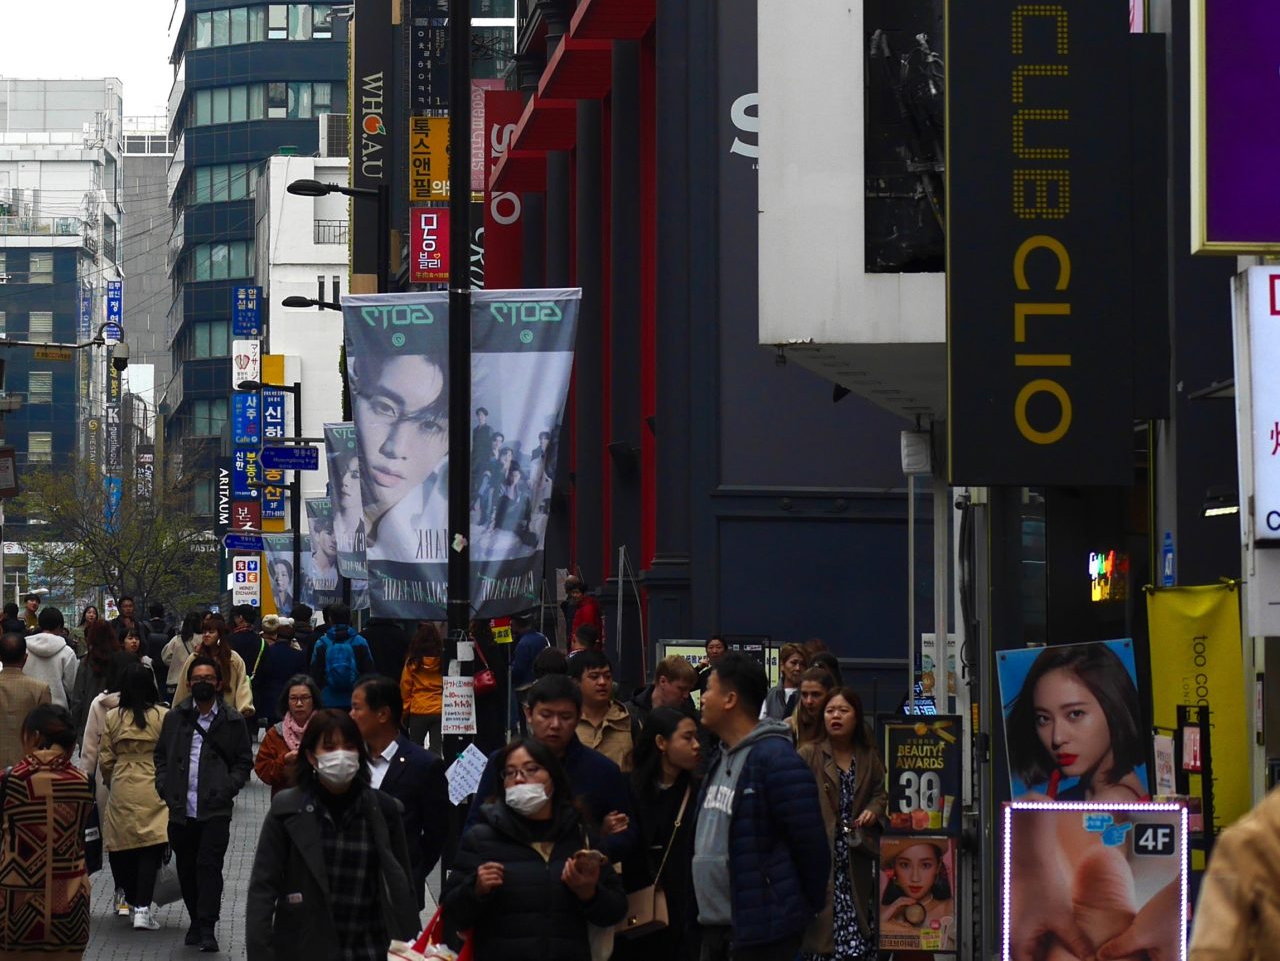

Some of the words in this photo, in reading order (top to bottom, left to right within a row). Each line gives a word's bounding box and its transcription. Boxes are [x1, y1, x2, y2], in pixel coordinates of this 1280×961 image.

[1011, 5, 1070, 220] CLUB
[1013, 234, 1073, 445] CLIO
[235, 451, 244, 471] 신한
[219, 467, 230, 525] ARITAUM
[1193, 634, 1208, 668] too
[896, 757, 945, 769] AWARDS
[1138, 828, 1171, 851] 4F
